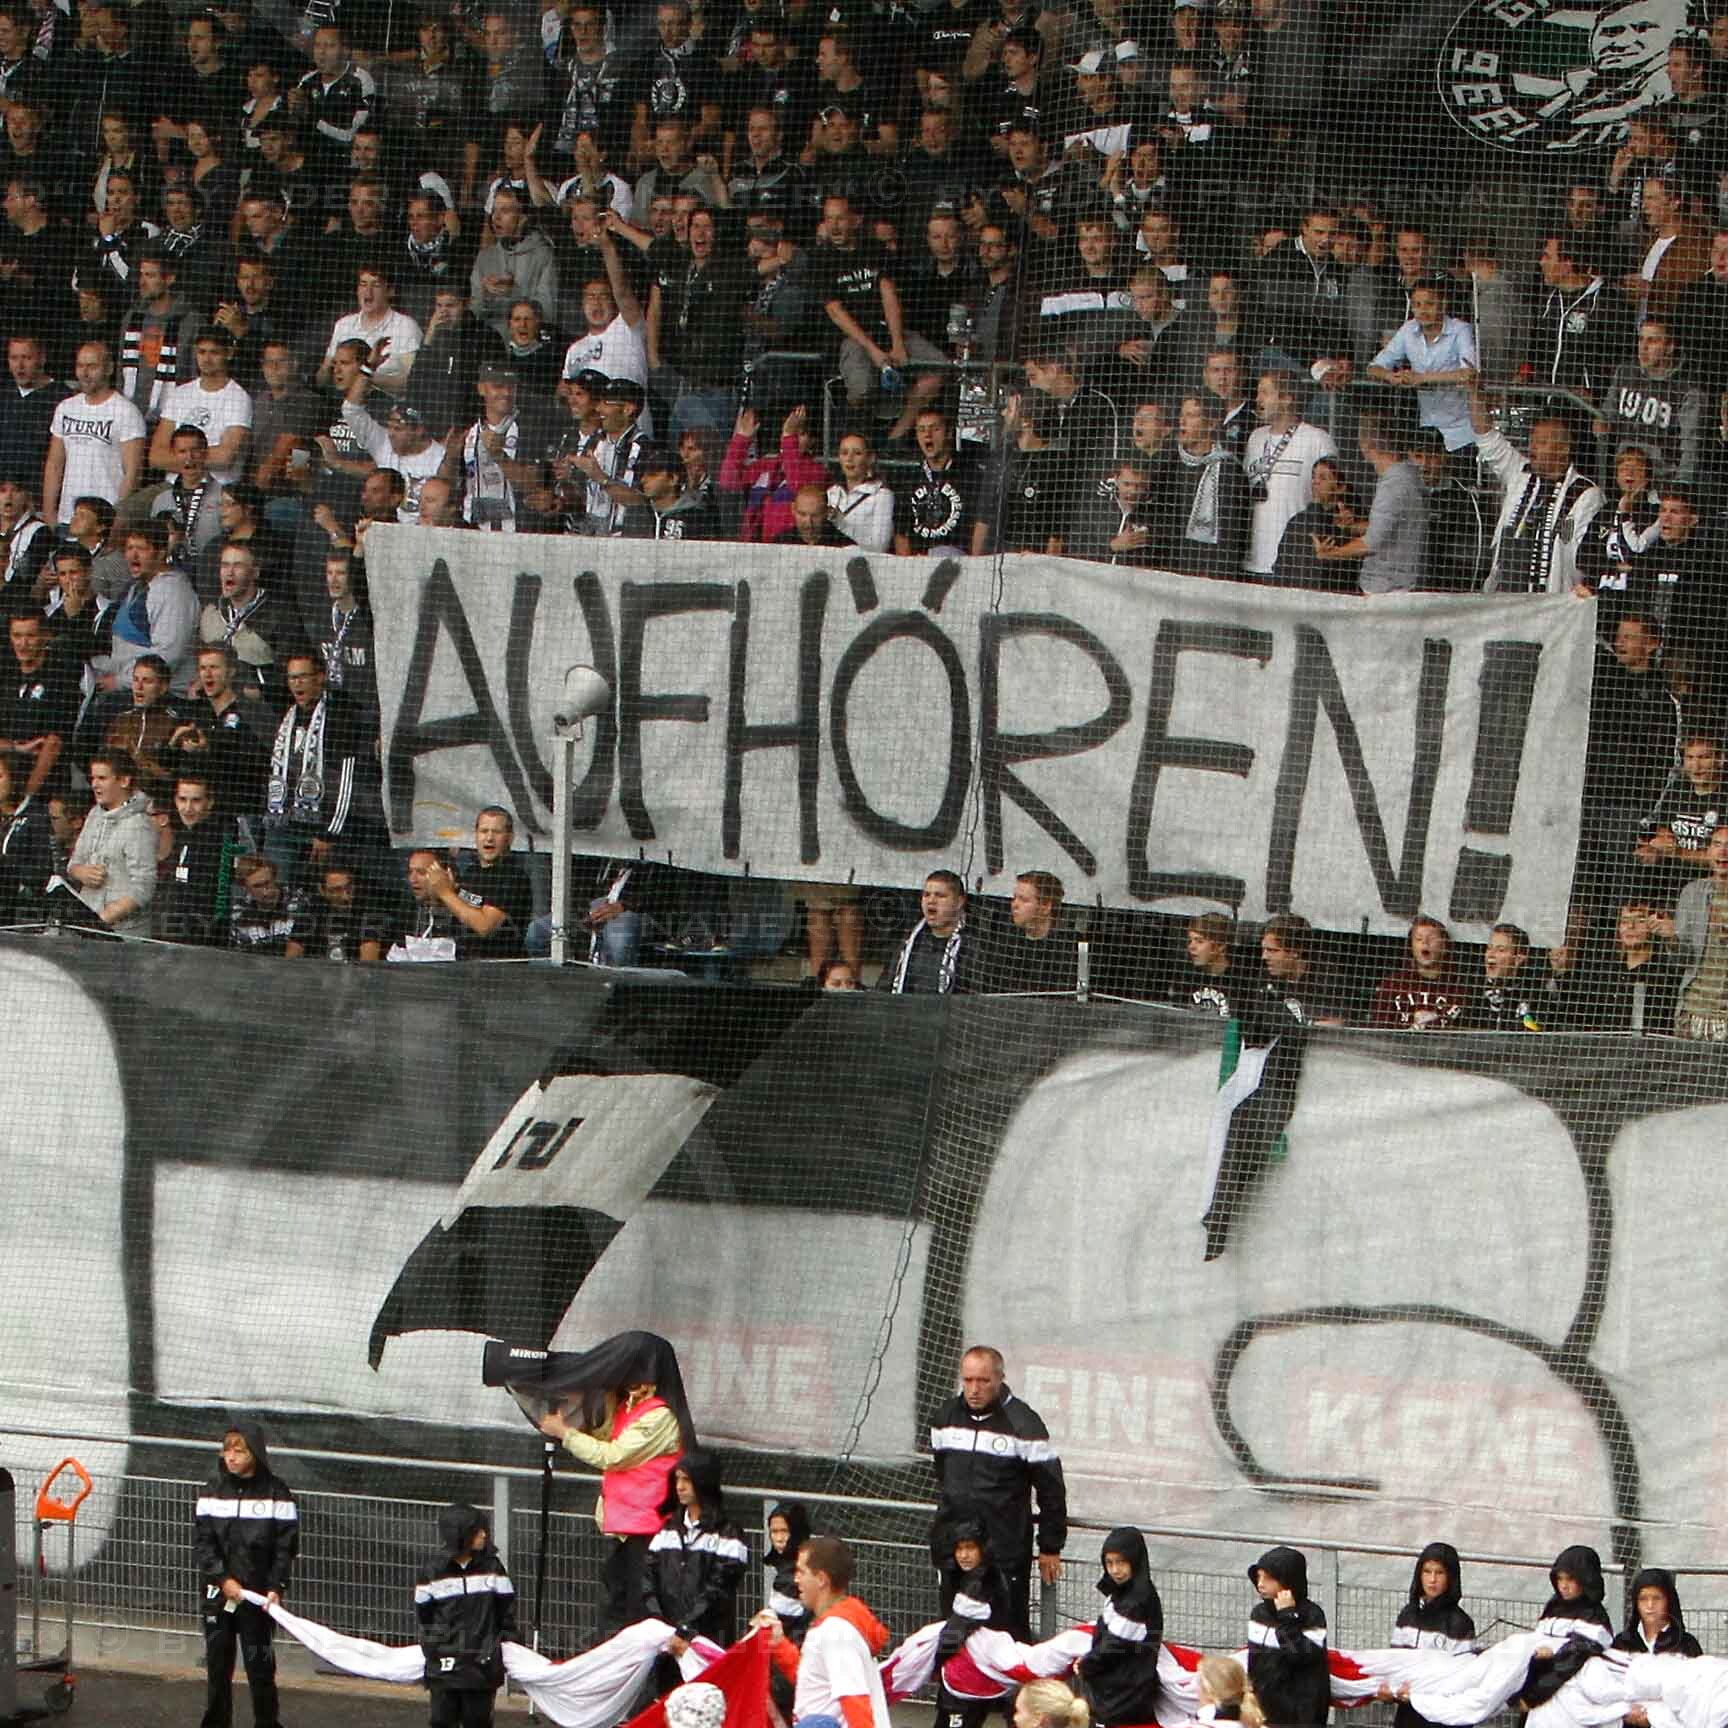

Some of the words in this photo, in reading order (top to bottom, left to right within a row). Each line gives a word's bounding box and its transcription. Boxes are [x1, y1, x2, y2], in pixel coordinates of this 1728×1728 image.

[388, 554, 1542, 925] AUFHÖREN!
[438, 1655, 456, 1673] 13
[948, 1713, 964, 1728] 15
